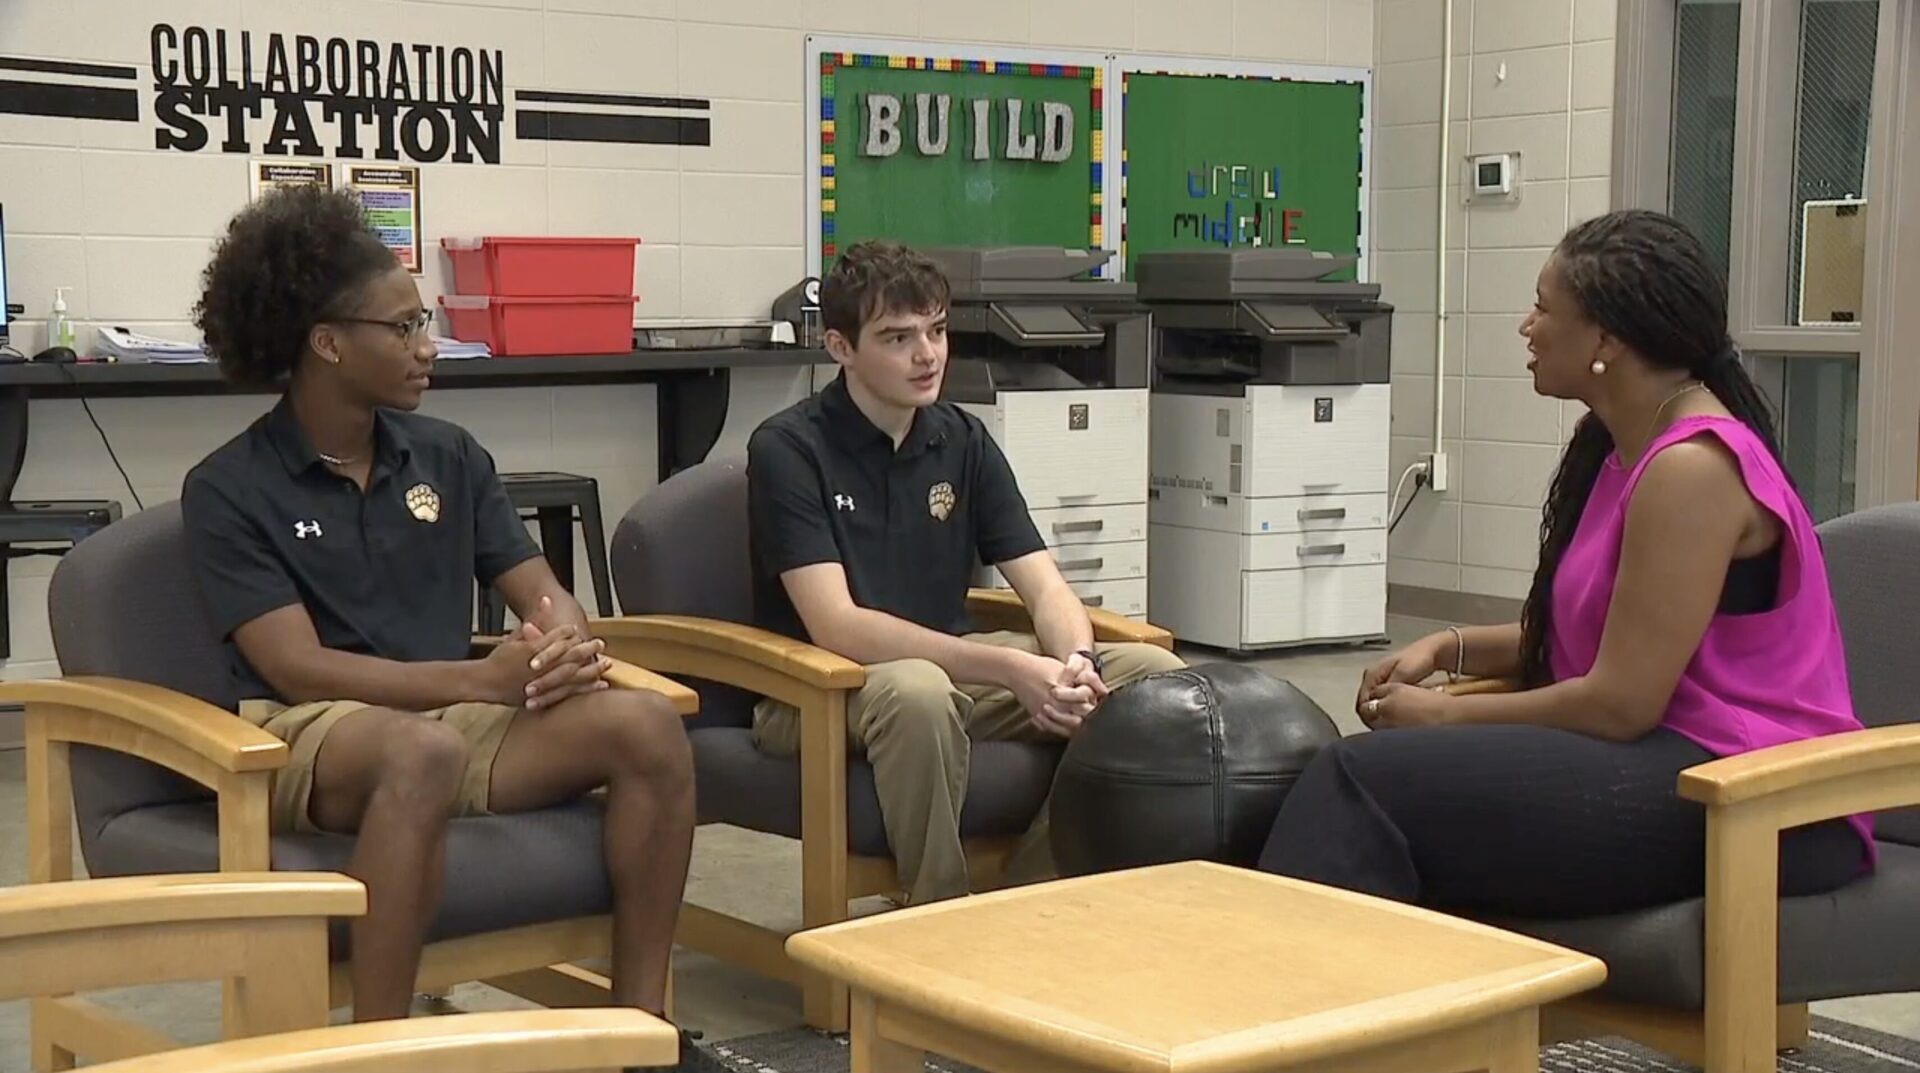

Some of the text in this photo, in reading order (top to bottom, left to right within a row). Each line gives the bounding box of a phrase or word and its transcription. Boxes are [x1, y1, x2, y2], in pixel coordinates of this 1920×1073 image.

[150, 23, 503, 105] COLLABORATION
[153, 84, 504, 164] STATION
[860, 92, 1074, 162] BUILD
